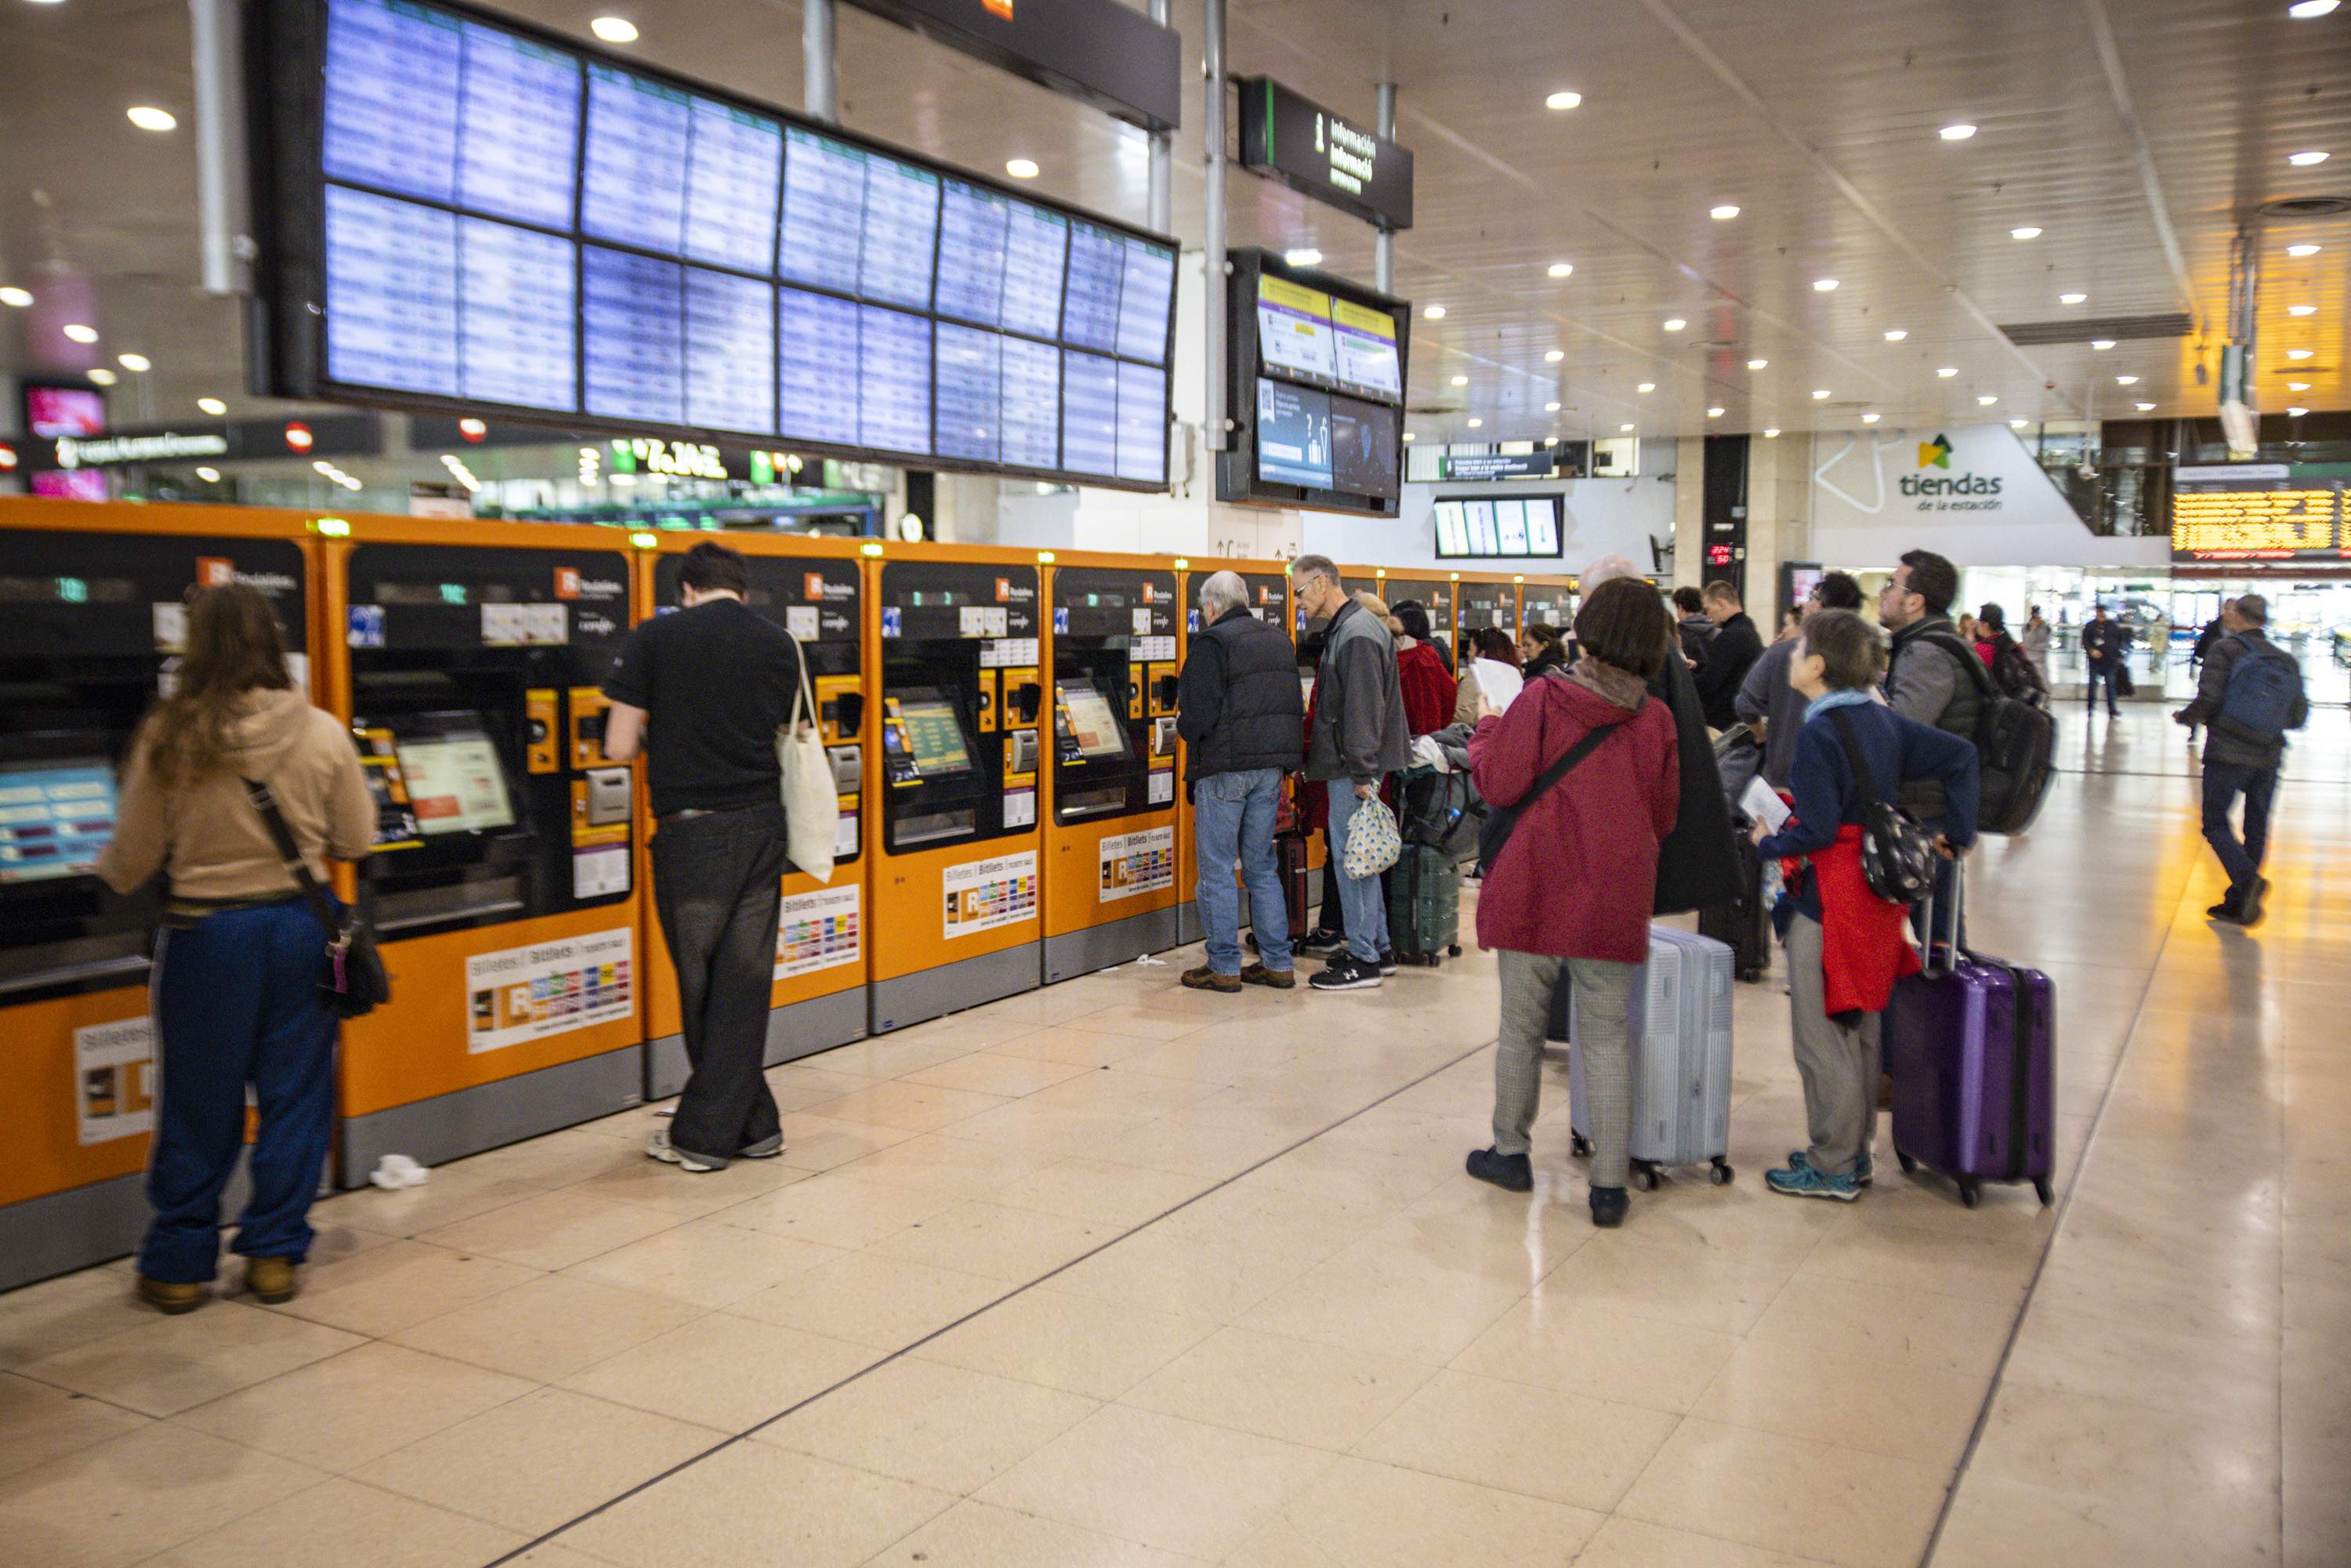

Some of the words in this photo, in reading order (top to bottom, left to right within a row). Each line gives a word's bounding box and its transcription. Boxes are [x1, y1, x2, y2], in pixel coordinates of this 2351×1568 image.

[1900, 473, 2003, 495] tiendas
[1917, 500, 1933, 511] de
[1936, 500, 1946, 510] la
[1951, 498, 2003, 510] estación
[1154, 616, 1169, 628] renfe
[1102, 840, 1123, 851] Billetes
[1128, 835, 1147, 846] Bitllets
